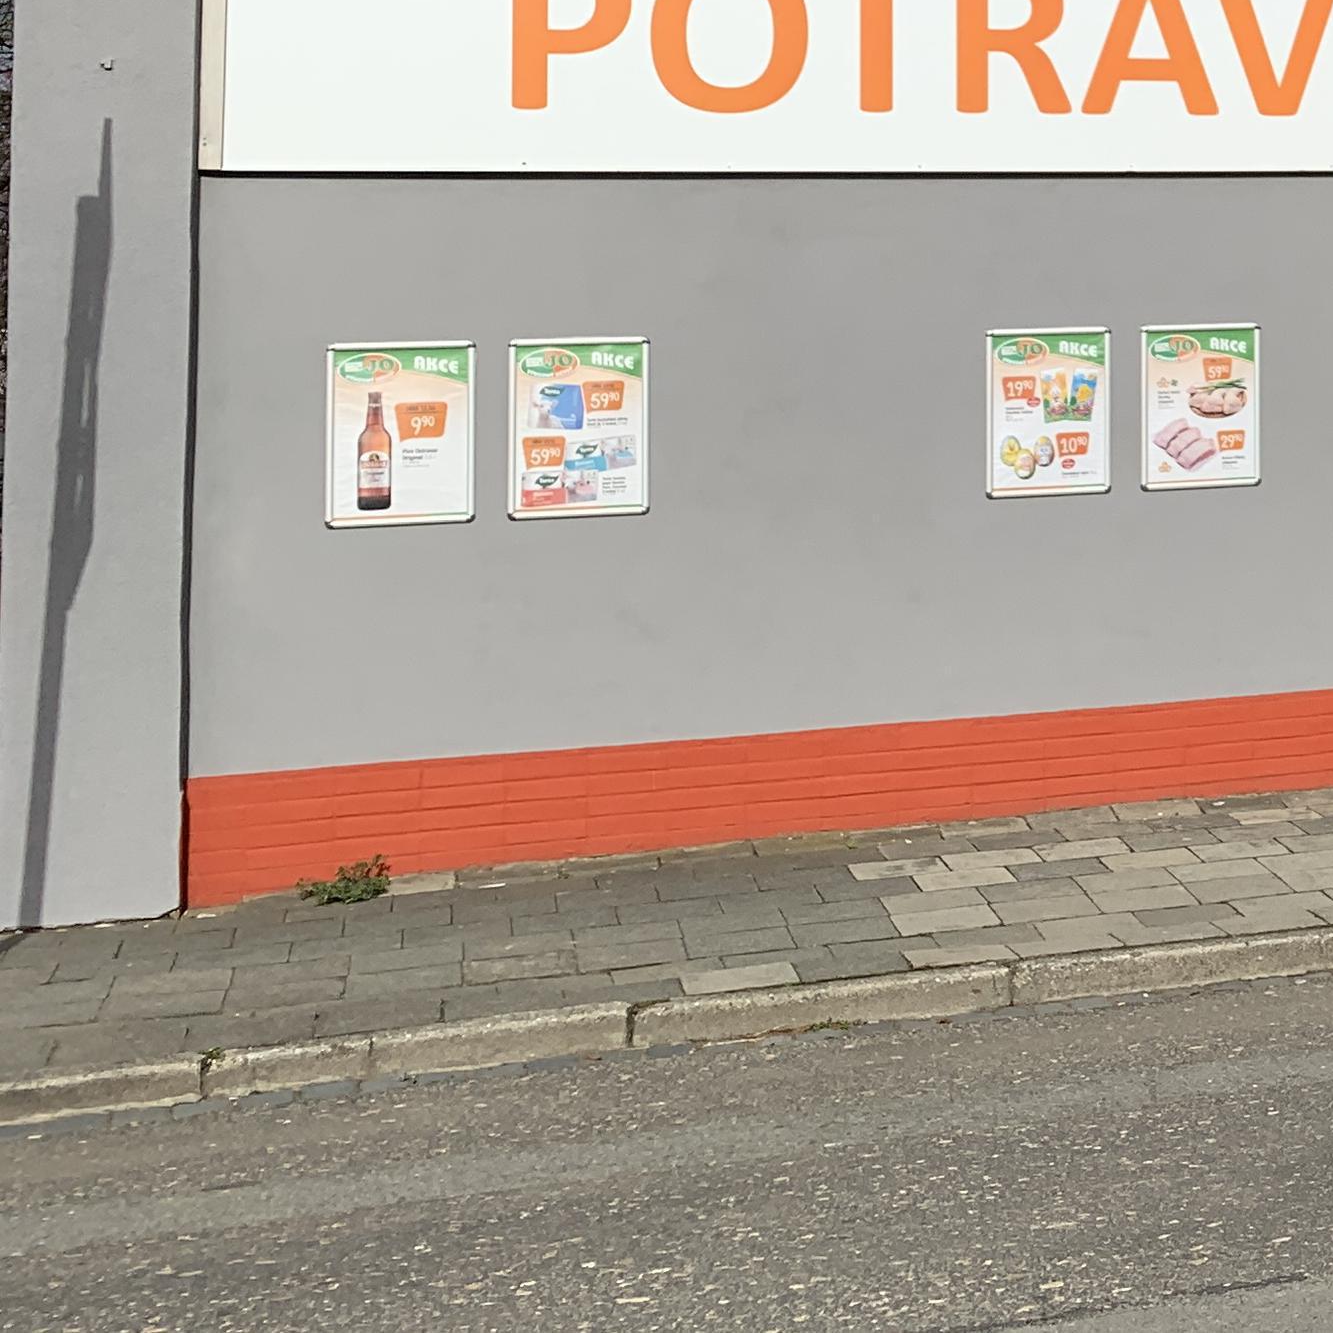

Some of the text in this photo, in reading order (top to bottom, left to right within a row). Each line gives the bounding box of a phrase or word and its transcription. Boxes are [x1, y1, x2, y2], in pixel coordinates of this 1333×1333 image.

[1059, 340, 1098, 357] AKCE
[1210, 337, 1247, 353] AKCE
[414, 355, 459, 375] AKCE
[591, 351, 635, 370] AKCE
